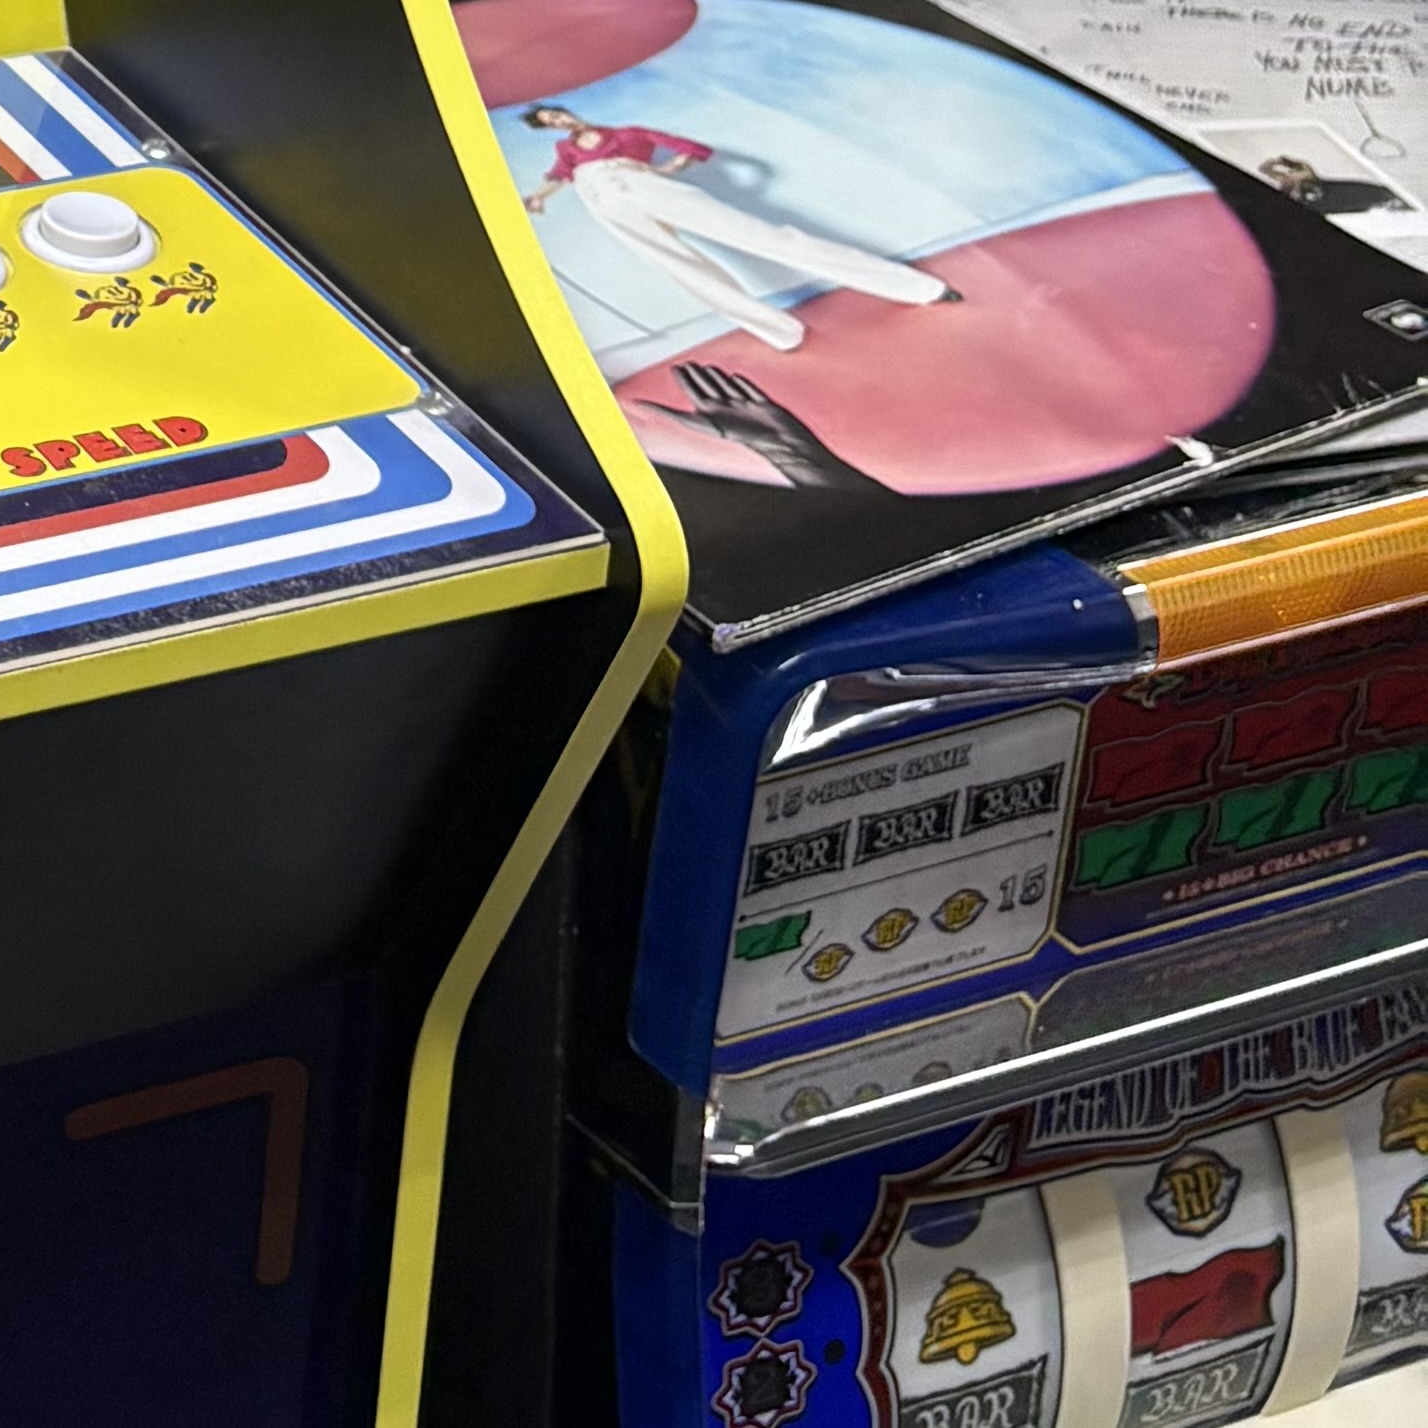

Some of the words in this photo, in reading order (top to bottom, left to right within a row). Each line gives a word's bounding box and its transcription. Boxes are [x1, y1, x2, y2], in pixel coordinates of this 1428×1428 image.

[0, 414, 210, 478] SPEED
[764, 838, 833, 881] BAR
[875, 806, 940, 848] BAR
[981, 774, 1050, 820] BAR
[996, 862, 1049, 914] 15
[1140, 1360, 1240, 1424] BAR
